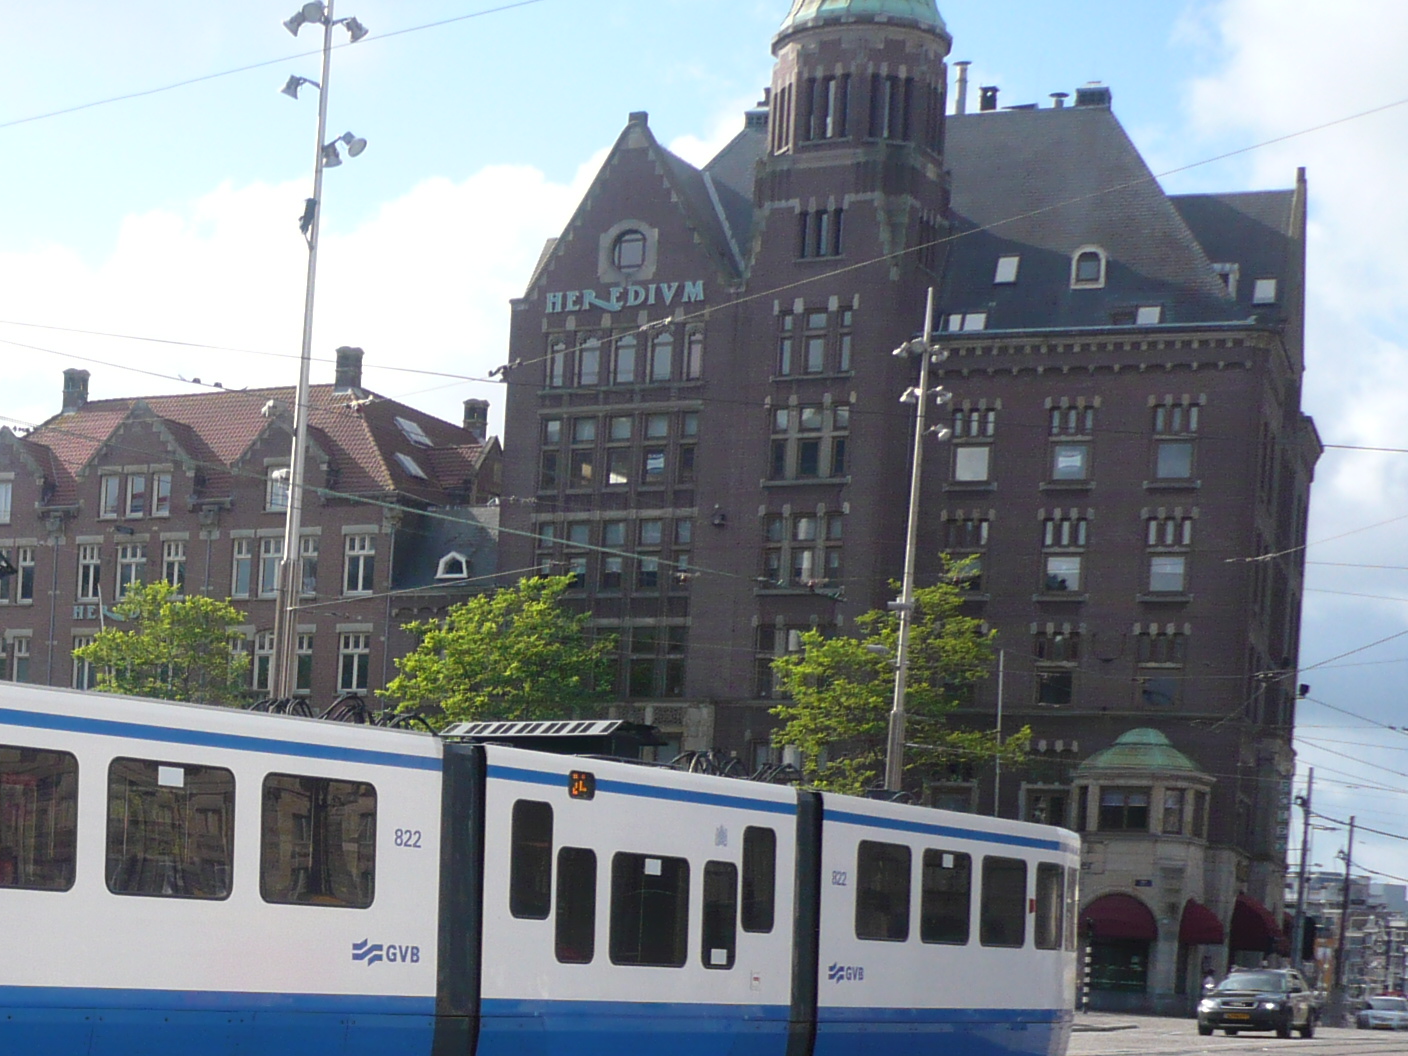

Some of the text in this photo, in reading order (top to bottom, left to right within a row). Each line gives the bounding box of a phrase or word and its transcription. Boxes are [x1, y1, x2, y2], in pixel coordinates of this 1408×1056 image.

[545, 280, 705, 314] HEREDIVM
[394, 828, 422, 848] 822
[832, 870, 847, 887] 822
[386, 944, 420, 963] GVB
[845, 966, 865, 981] GVB
